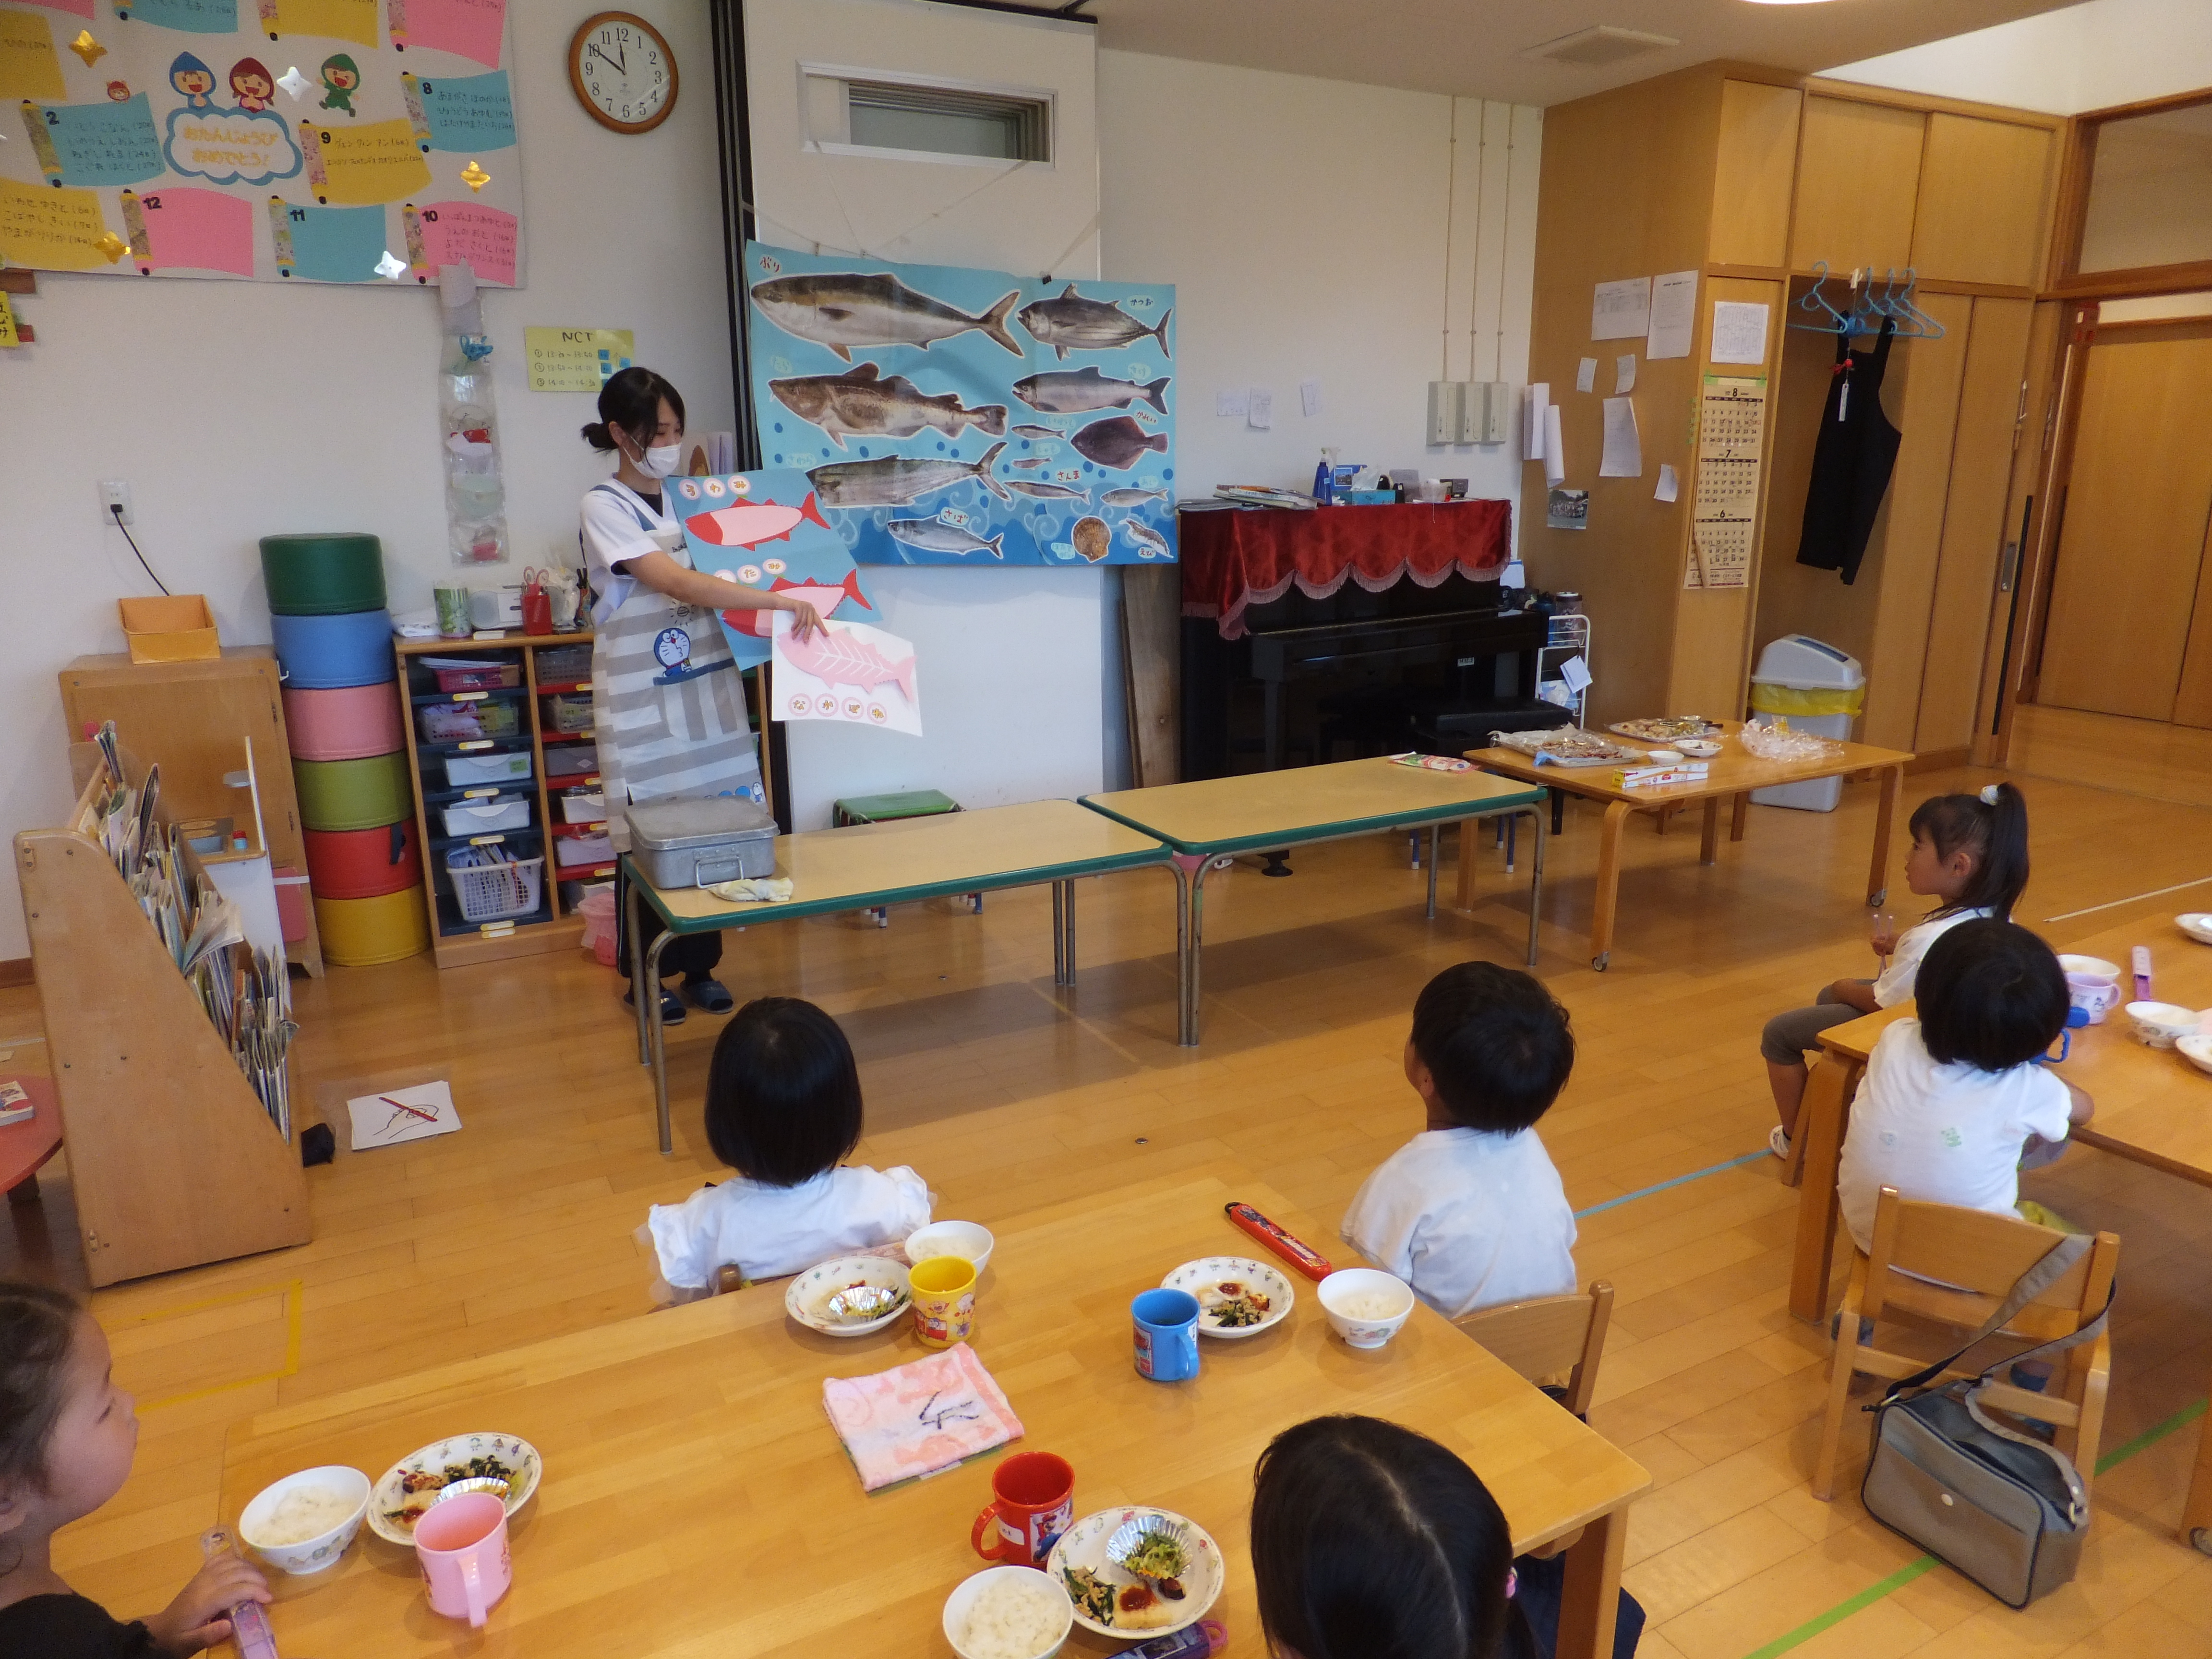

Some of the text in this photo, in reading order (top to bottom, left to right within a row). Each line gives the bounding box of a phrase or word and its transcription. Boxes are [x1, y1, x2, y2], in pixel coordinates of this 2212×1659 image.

[601, 31, 611, 45] 11
[616, 28, 628, 42] 12
[638, 36, 641, 48] 1
[588, 43, 600, 57] 10
[649, 51, 657, 64] 2
[585, 62, 593, 75] 9
[655, 71, 662, 84] 3
[422, 82, 433, 95] 8
[592, 82, 600, 96] 8
[650, 90, 657, 103] 4
[606, 98, 613, 111] 7
[639, 102, 646, 115] 5
[46, 111, 60, 125] 2
[623, 105, 630, 118] 6
[321, 132, 331, 144] 9
[143, 197, 162, 210] 12
[290, 209, 305, 222] 11
[422, 210, 438, 222] 10
[759, 256, 780, 272] ぶり
[1130, 298, 1153, 306] かつお
[562, 331, 593, 343] NCT
[1732, 388, 1737, 397] 8
[1726, 449, 1731, 458] 7
[1057, 469, 1080, 481] さんま
[944, 509, 968, 523] さば
[1720, 509, 1725, 518] 6
